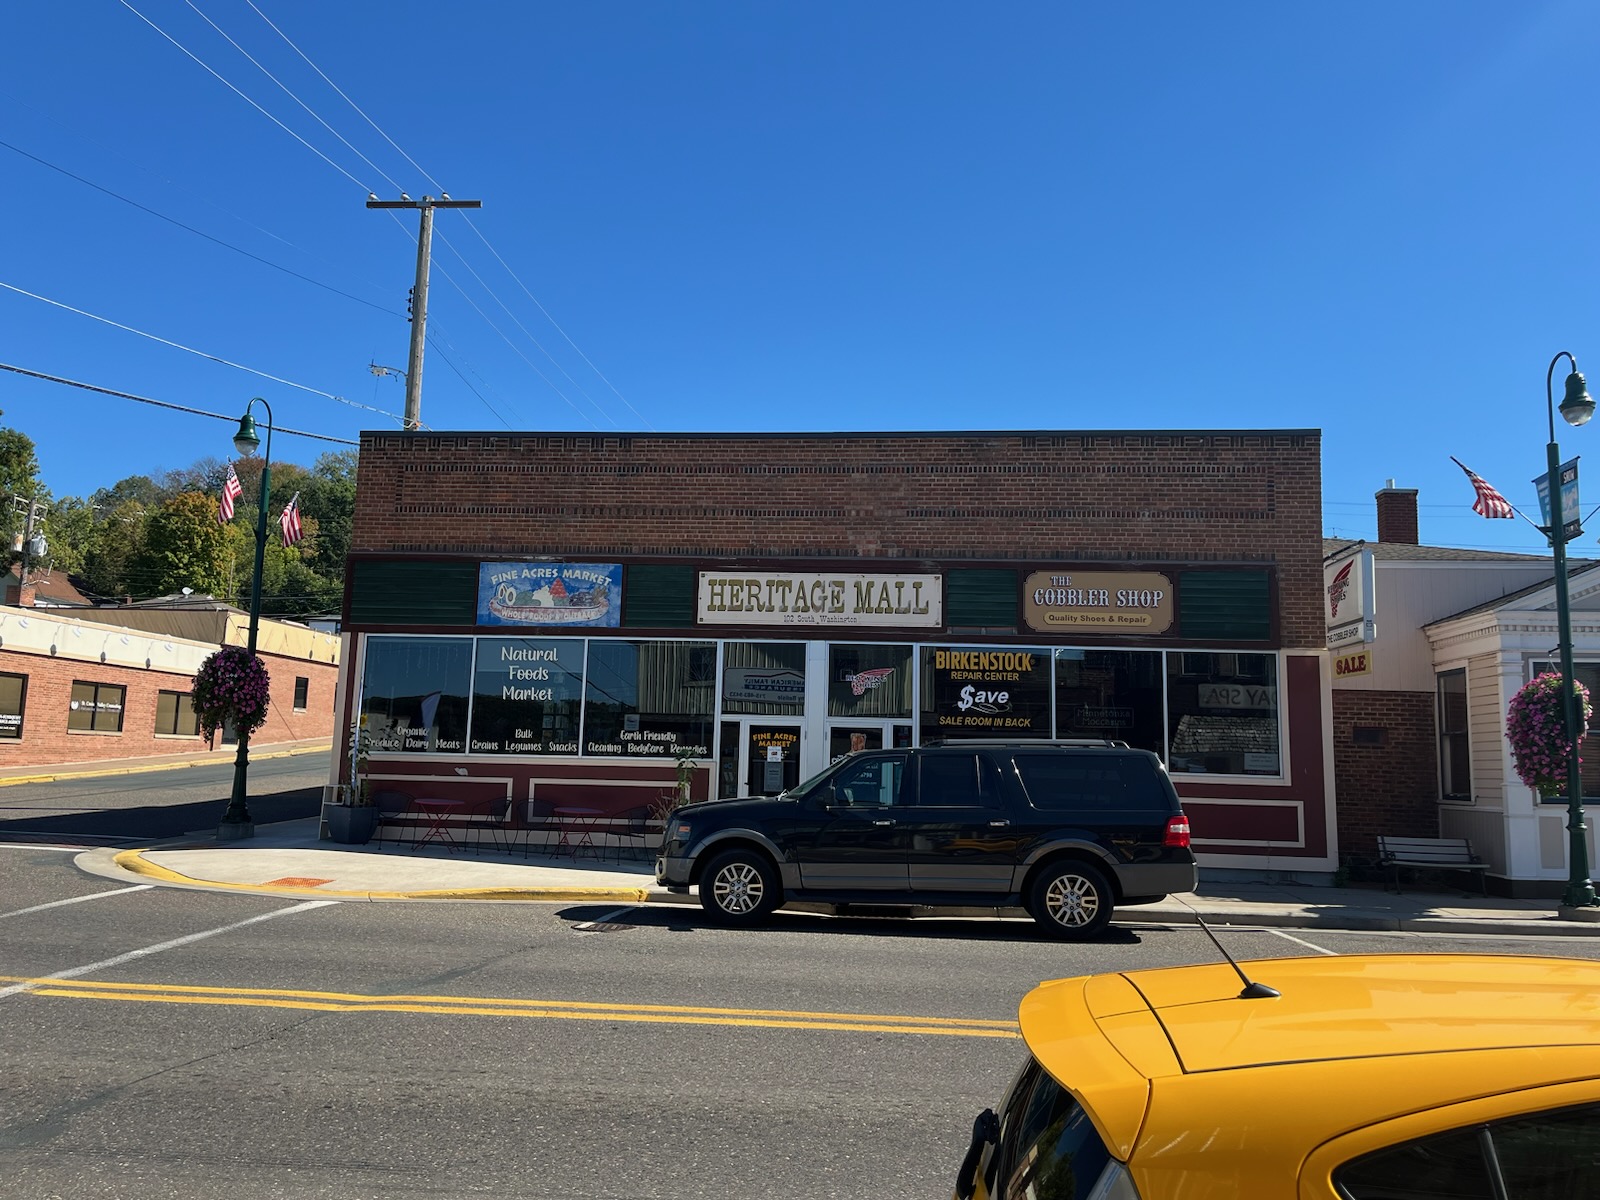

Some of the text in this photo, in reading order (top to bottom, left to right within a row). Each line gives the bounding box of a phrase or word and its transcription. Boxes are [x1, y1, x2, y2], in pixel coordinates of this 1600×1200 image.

[490, 568, 612, 586] FINE ACRES MARKET
[1050, 576, 1072, 587] THE
[707, 579, 929, 614] HERITAGE MALL
[1033, 588, 1164, 608] COBBLER SHOP
[783, 615, 858, 624] 102 South Washington
[1048, 614, 1078, 623] Quality
[1080, 614, 1106, 622] Shoes
[1117, 616, 1147, 624] Repair
[1333, 630, 1349, 642] COBBLER
[1348, 626, 1359, 638] SHOP
[501, 646, 558, 661] Natural
[936, 651, 1032, 671] BIRKENSTOCK
[1336, 655, 1367, 675] SALE
[509, 665, 549, 680] Foods
[951, 671, 1020, 681] REPAIR CENTER
[502, 685, 554, 701] Market
[957, 684, 1009, 711] $ave
[939, 716, 1032, 727] SALE ROOM IN BACK
[397, 726, 429, 738] Organic
[515, 728, 533, 739] Bulk
[620, 730, 677, 742] Earth Friendly
[752, 732, 797, 742] FINE ACRES
[405, 737, 429, 749] Dairy
[435, 738, 461, 749] Meats
[471, 739, 578, 752] Grains Legumes Snacks
[588, 742, 622, 753] Cleaning
[758, 740, 791, 748] MARKET
